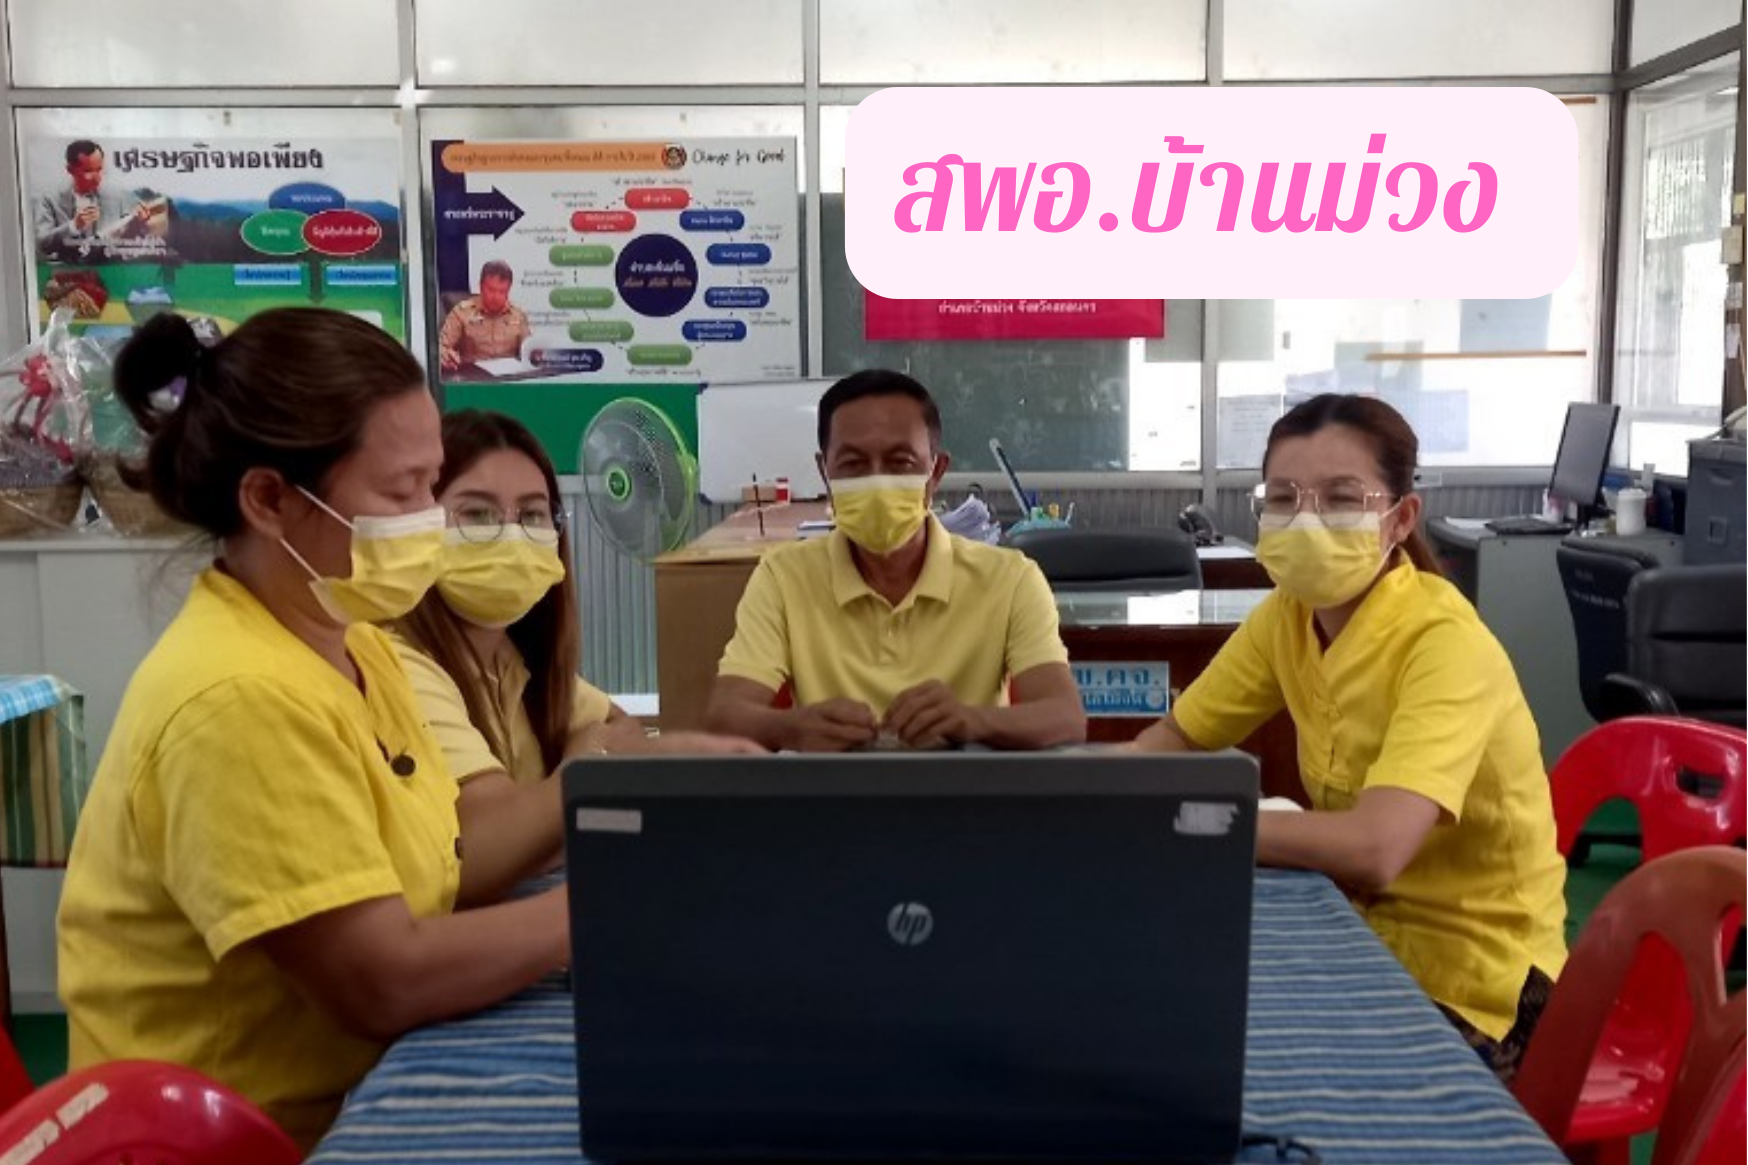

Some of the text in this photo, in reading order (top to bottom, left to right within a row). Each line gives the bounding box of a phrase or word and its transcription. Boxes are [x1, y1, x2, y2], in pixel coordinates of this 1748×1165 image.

[113, 141, 324, 173] เศรษฐกิจพอเพียง
[892, 902, 930, 945] hp
